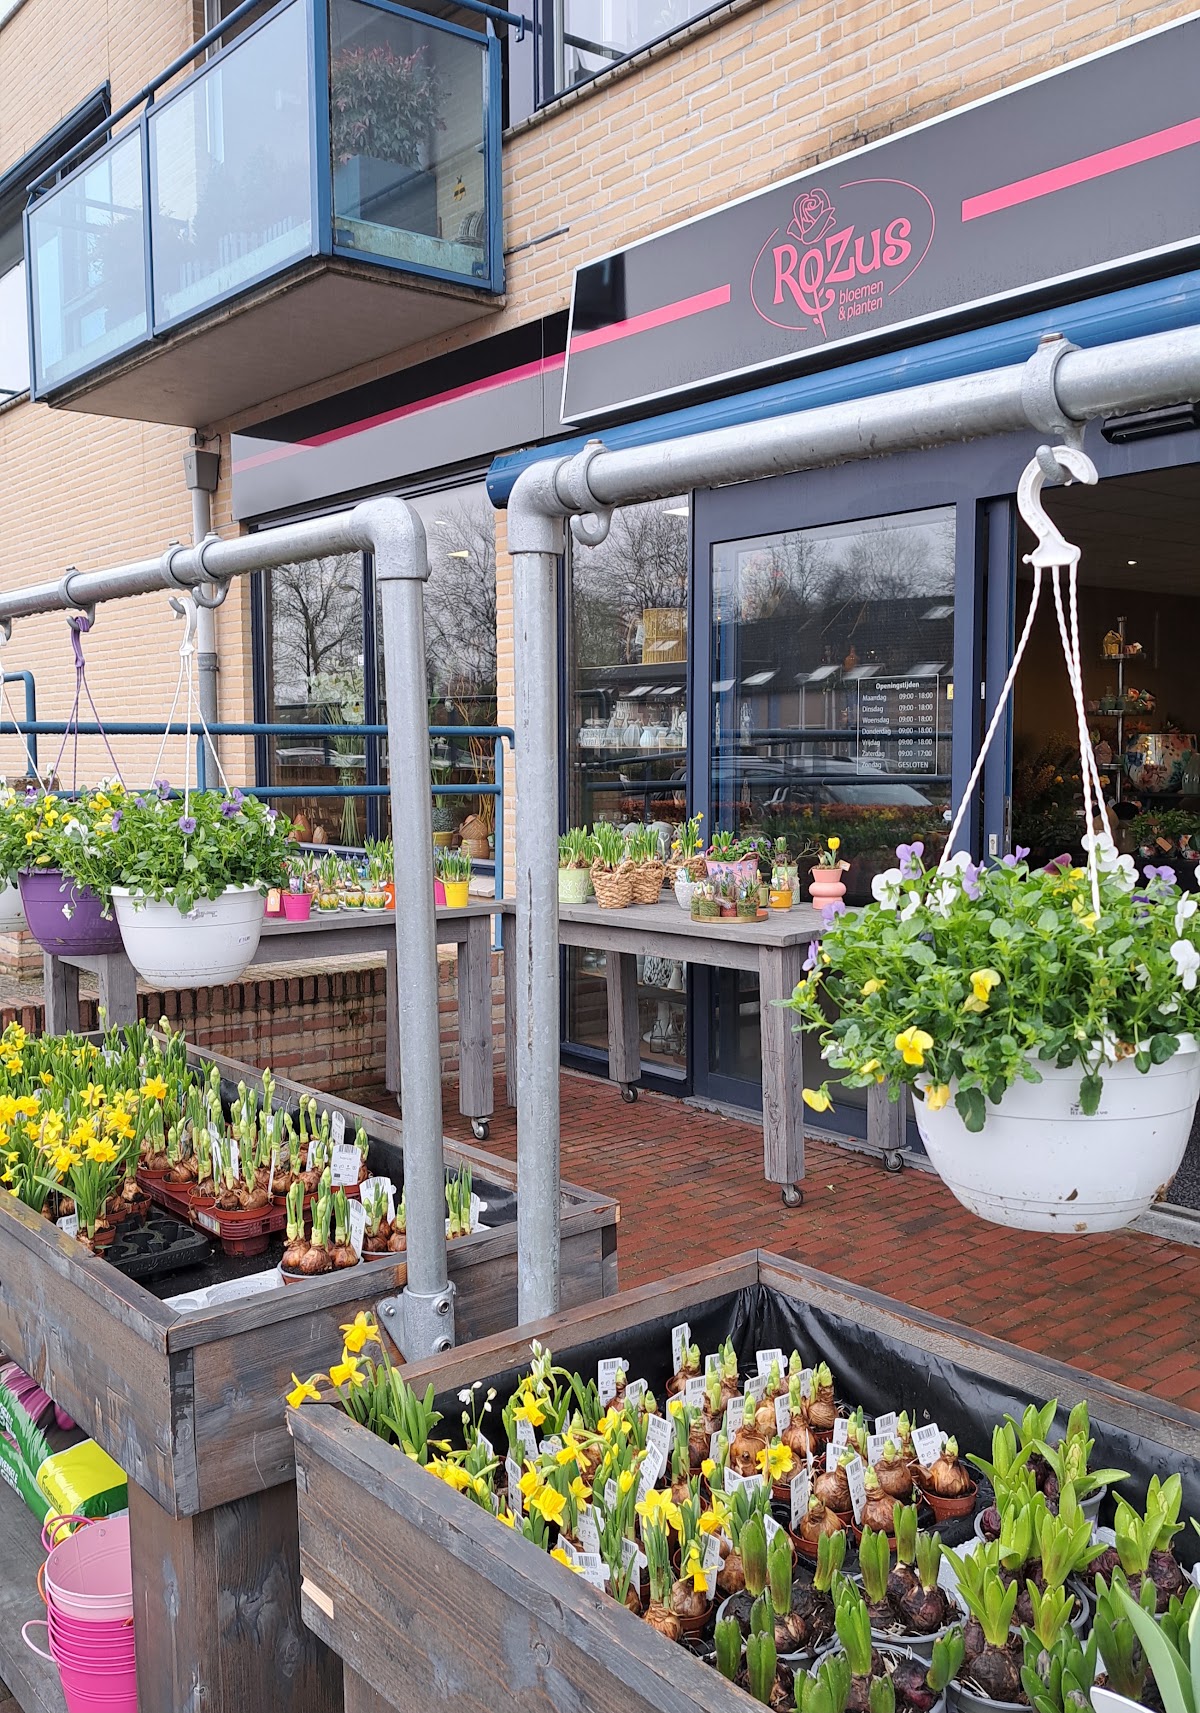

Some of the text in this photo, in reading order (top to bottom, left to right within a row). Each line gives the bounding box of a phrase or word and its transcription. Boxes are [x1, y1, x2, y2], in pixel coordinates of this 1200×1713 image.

[839, 280, 884, 305] bloemen
[838, 297, 883, 321] & planten
[875, 681, 920, 690] Openingstijden
[862, 694, 887, 702] Maandag
[862, 728, 892, 736] Donderdag
[861, 739, 881, 748] Vrijdag
[862, 750, 886, 758] Zaterdag
[861, 761, 929, 770] Zondag GESLOTEN
